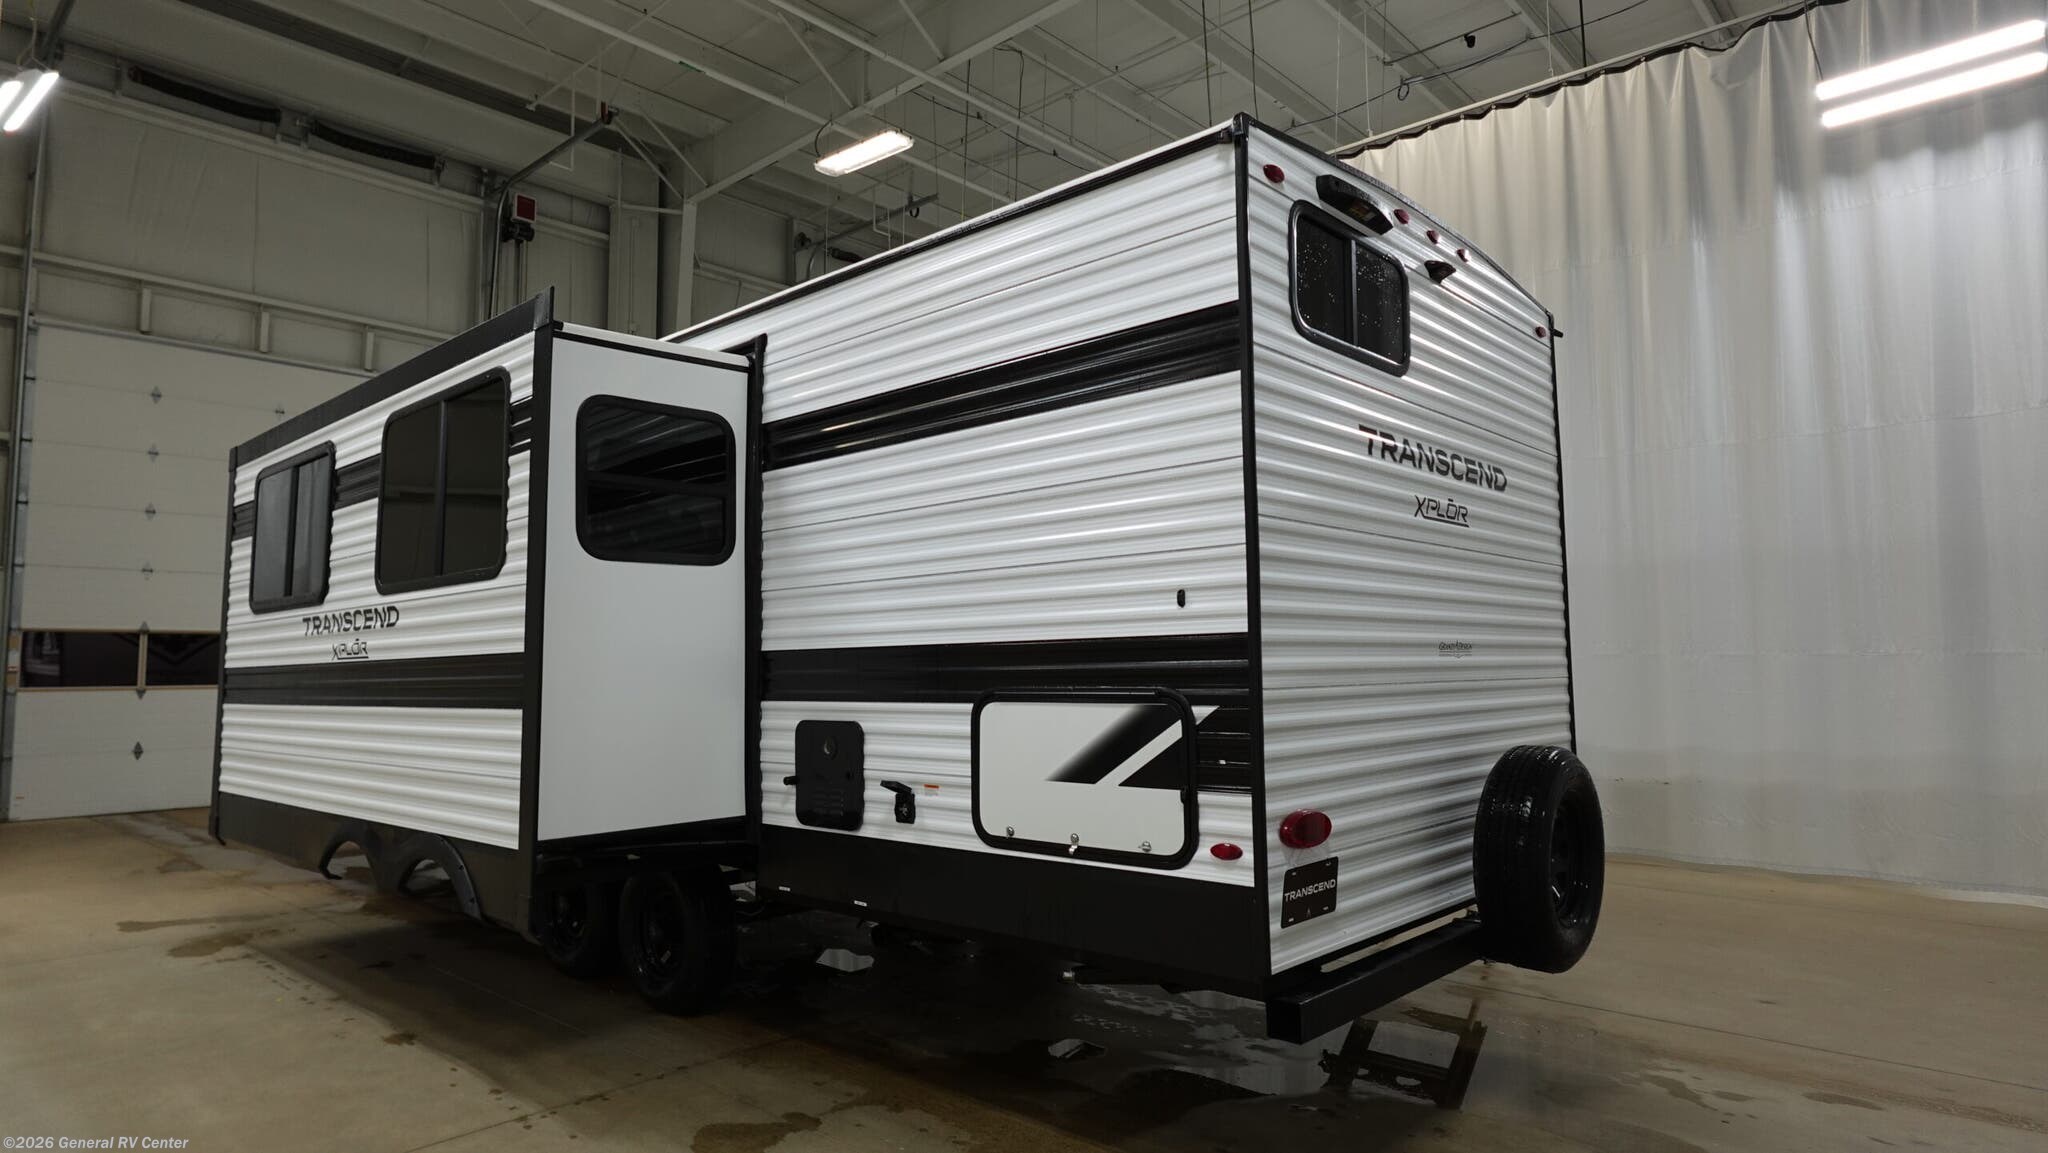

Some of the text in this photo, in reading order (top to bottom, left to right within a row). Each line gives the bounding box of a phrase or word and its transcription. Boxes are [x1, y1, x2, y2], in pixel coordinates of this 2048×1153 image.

[1358, 424, 1508, 492] TRANSCEND
[302, 605, 400, 637] TRANSCEND
[1284, 879, 1337, 903] TRANSCEND
